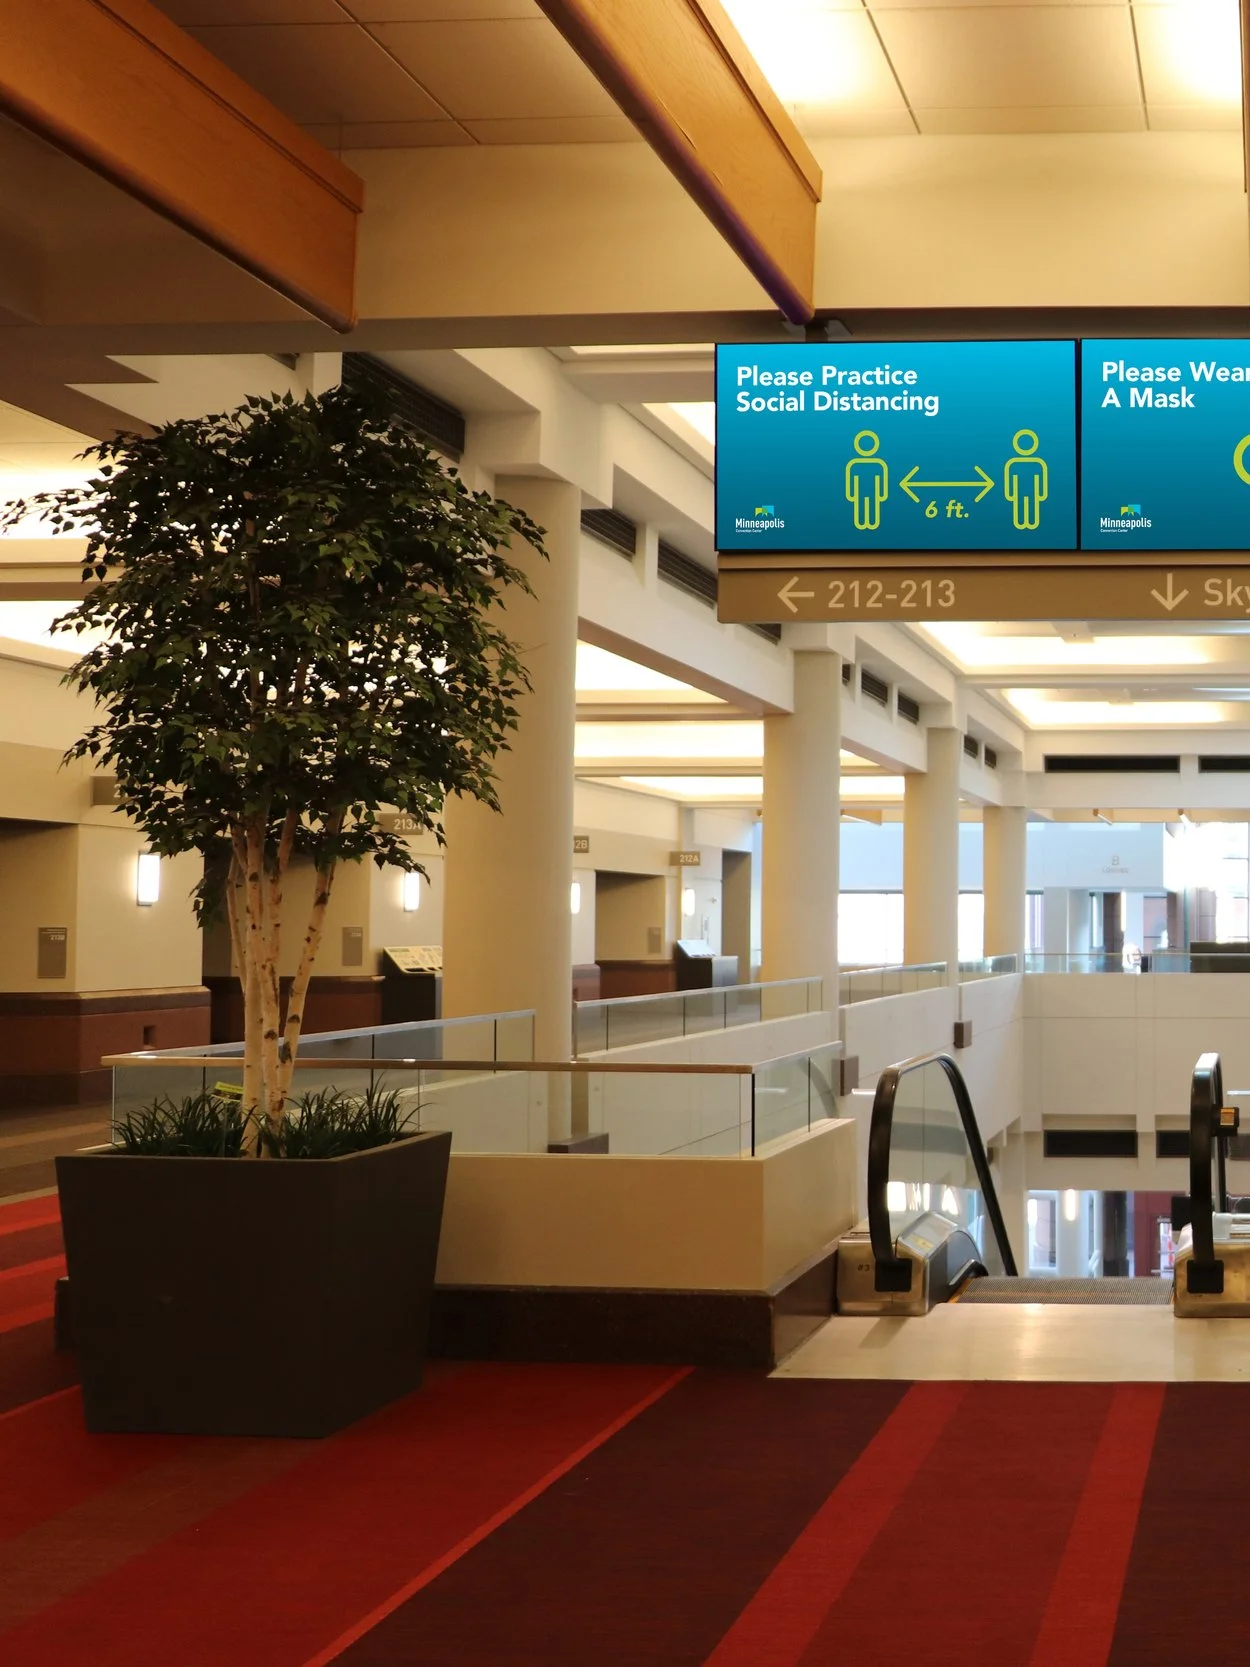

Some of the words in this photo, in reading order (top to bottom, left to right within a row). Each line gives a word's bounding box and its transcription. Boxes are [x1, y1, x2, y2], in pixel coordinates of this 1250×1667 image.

[738, 365, 813, 387] Please
[822, 364, 918, 386] Practice
[1102, 360, 1182, 383] Please
[736, 390, 805, 412] Social
[813, 390, 939, 417] Distancing
[1101, 387, 1122, 408] A
[1129, 386, 1196, 409] Mask
[925, 501, 938, 519] 6
[945, 499, 969, 519] ft.
[735, 518, 785, 530] Minneapolis
[1100, 517, 1152, 530] Minneapolis
[827, 579, 956, 608] 212-213
